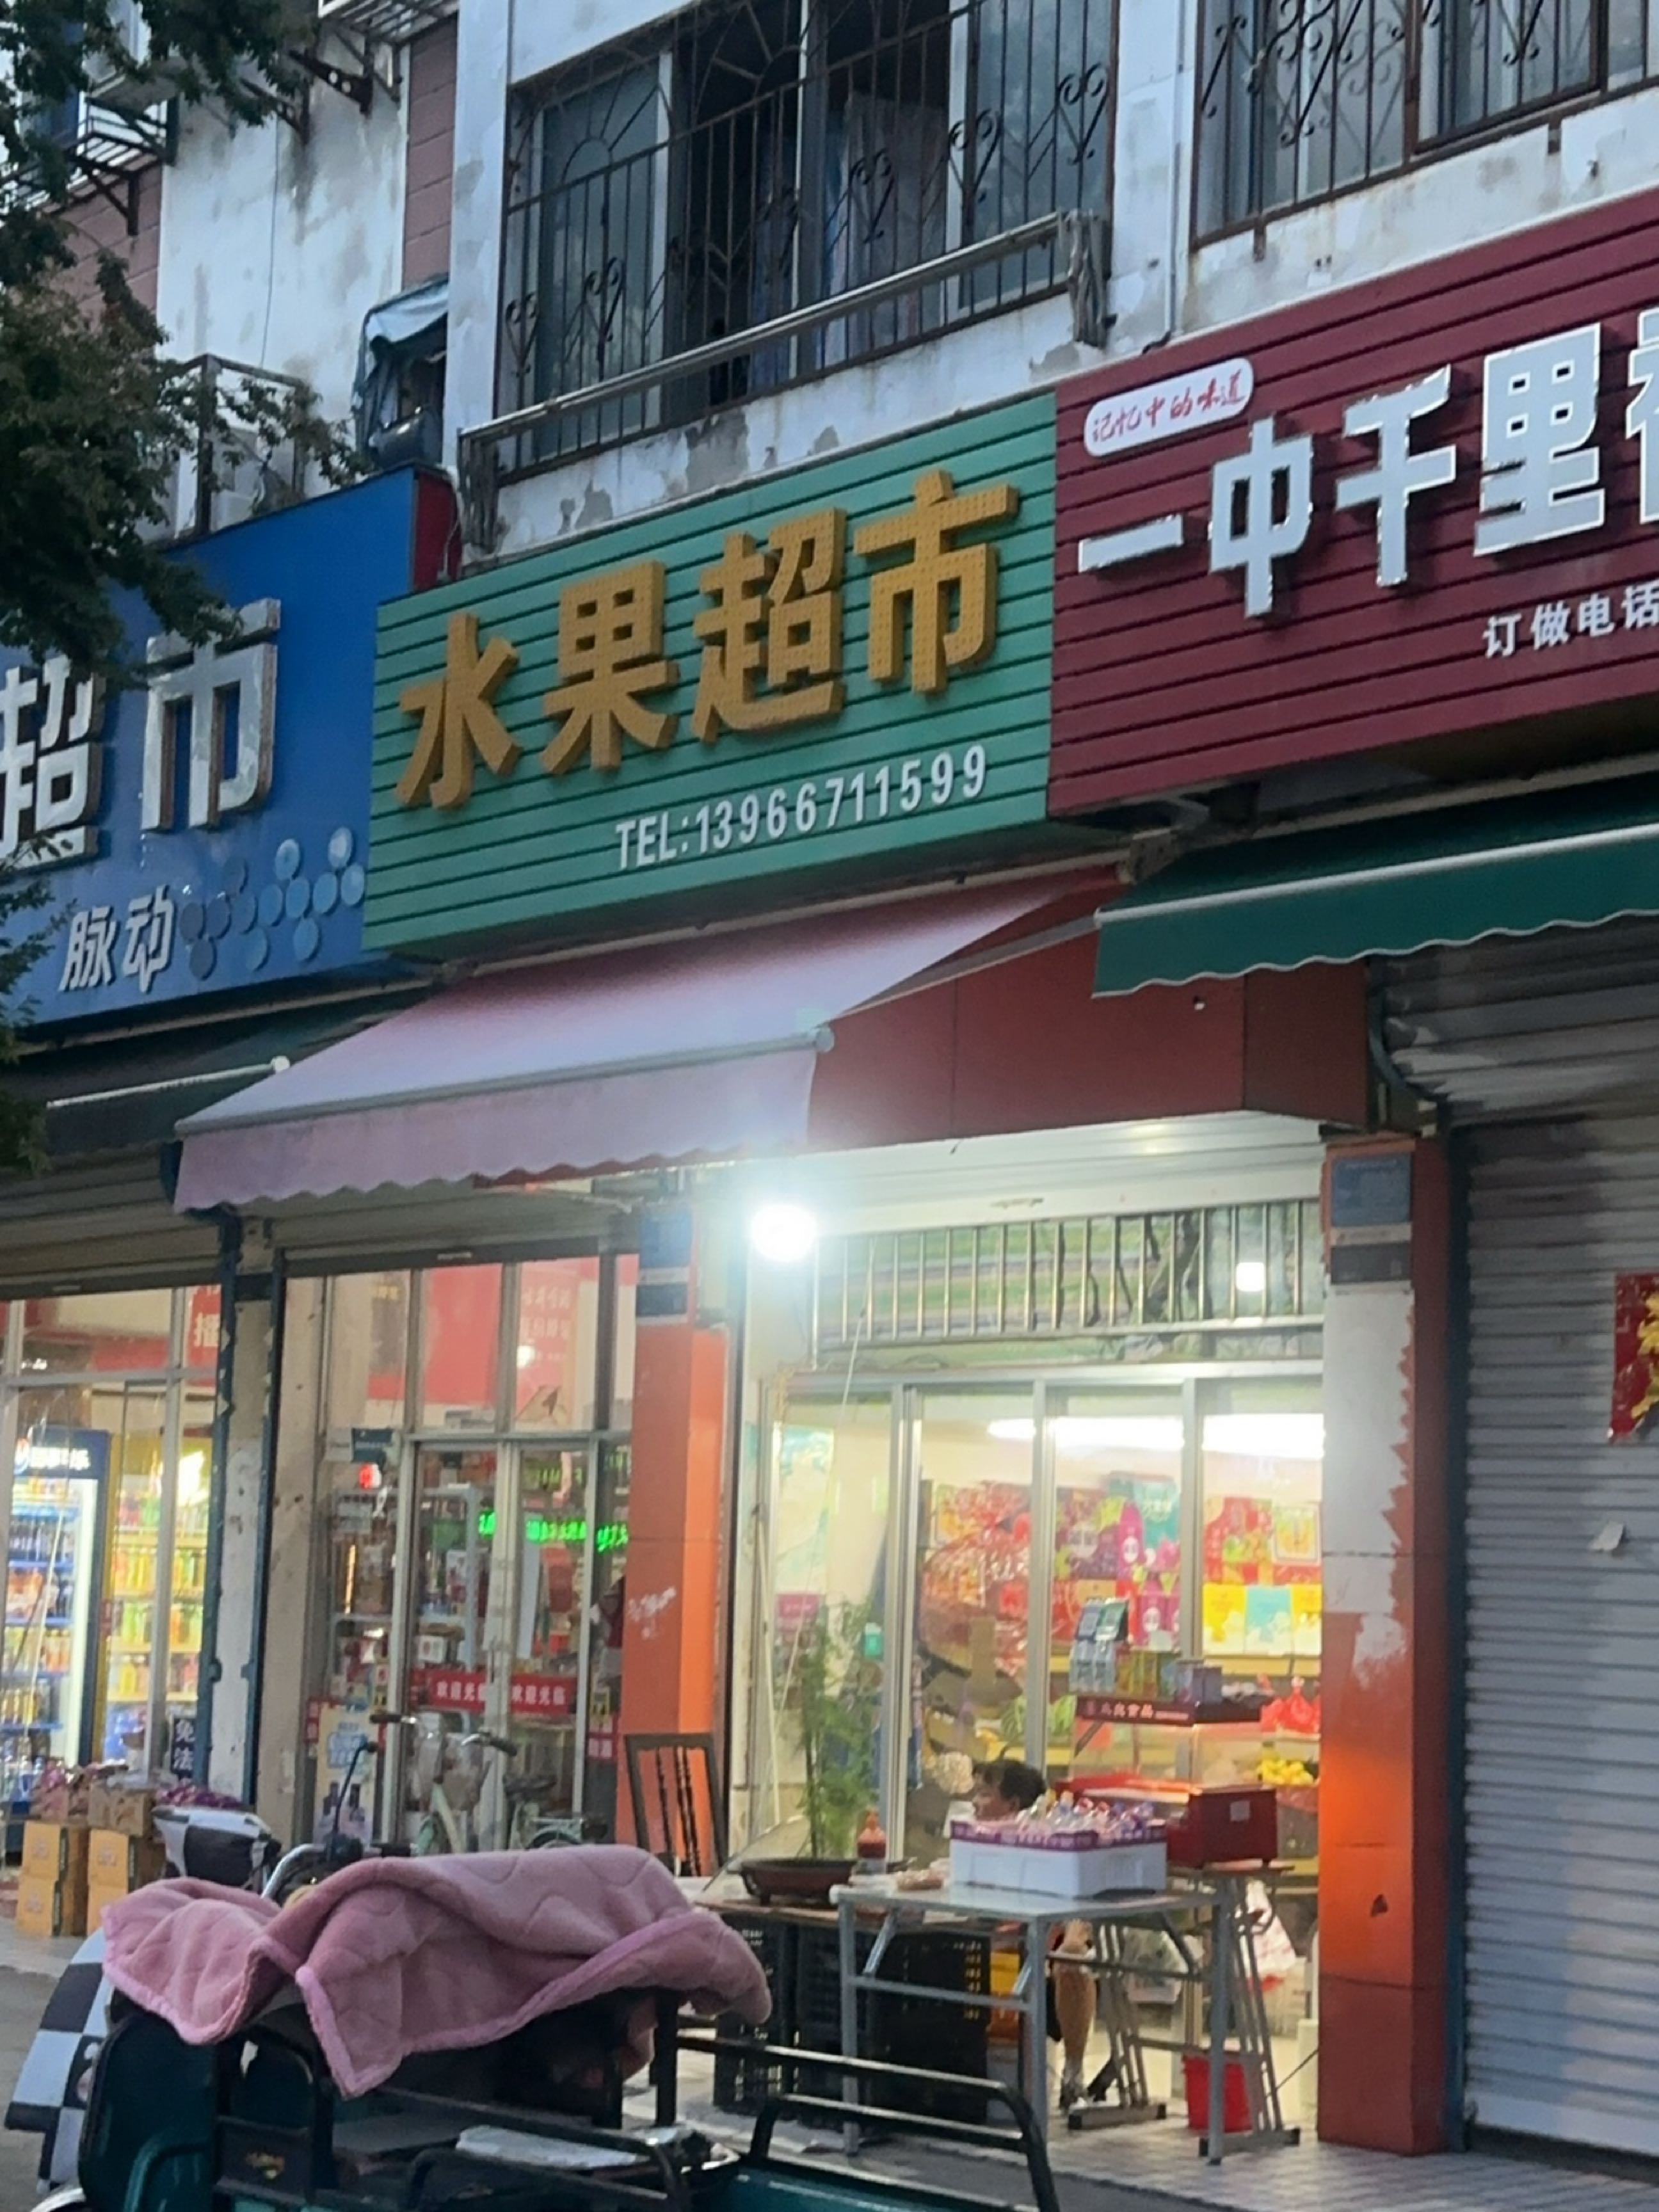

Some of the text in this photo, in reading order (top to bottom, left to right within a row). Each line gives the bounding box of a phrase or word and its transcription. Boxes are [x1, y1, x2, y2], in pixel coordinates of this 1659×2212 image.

[1093, 369, 1246, 437] 记忆中的味道
[395, 469, 1019, 809] 水果超市
[1482, 579, 1659, 659] 订做电话
[616, 744, 986, 869] TEL:13966711599
[58, 884, 174, 993] 脉动
